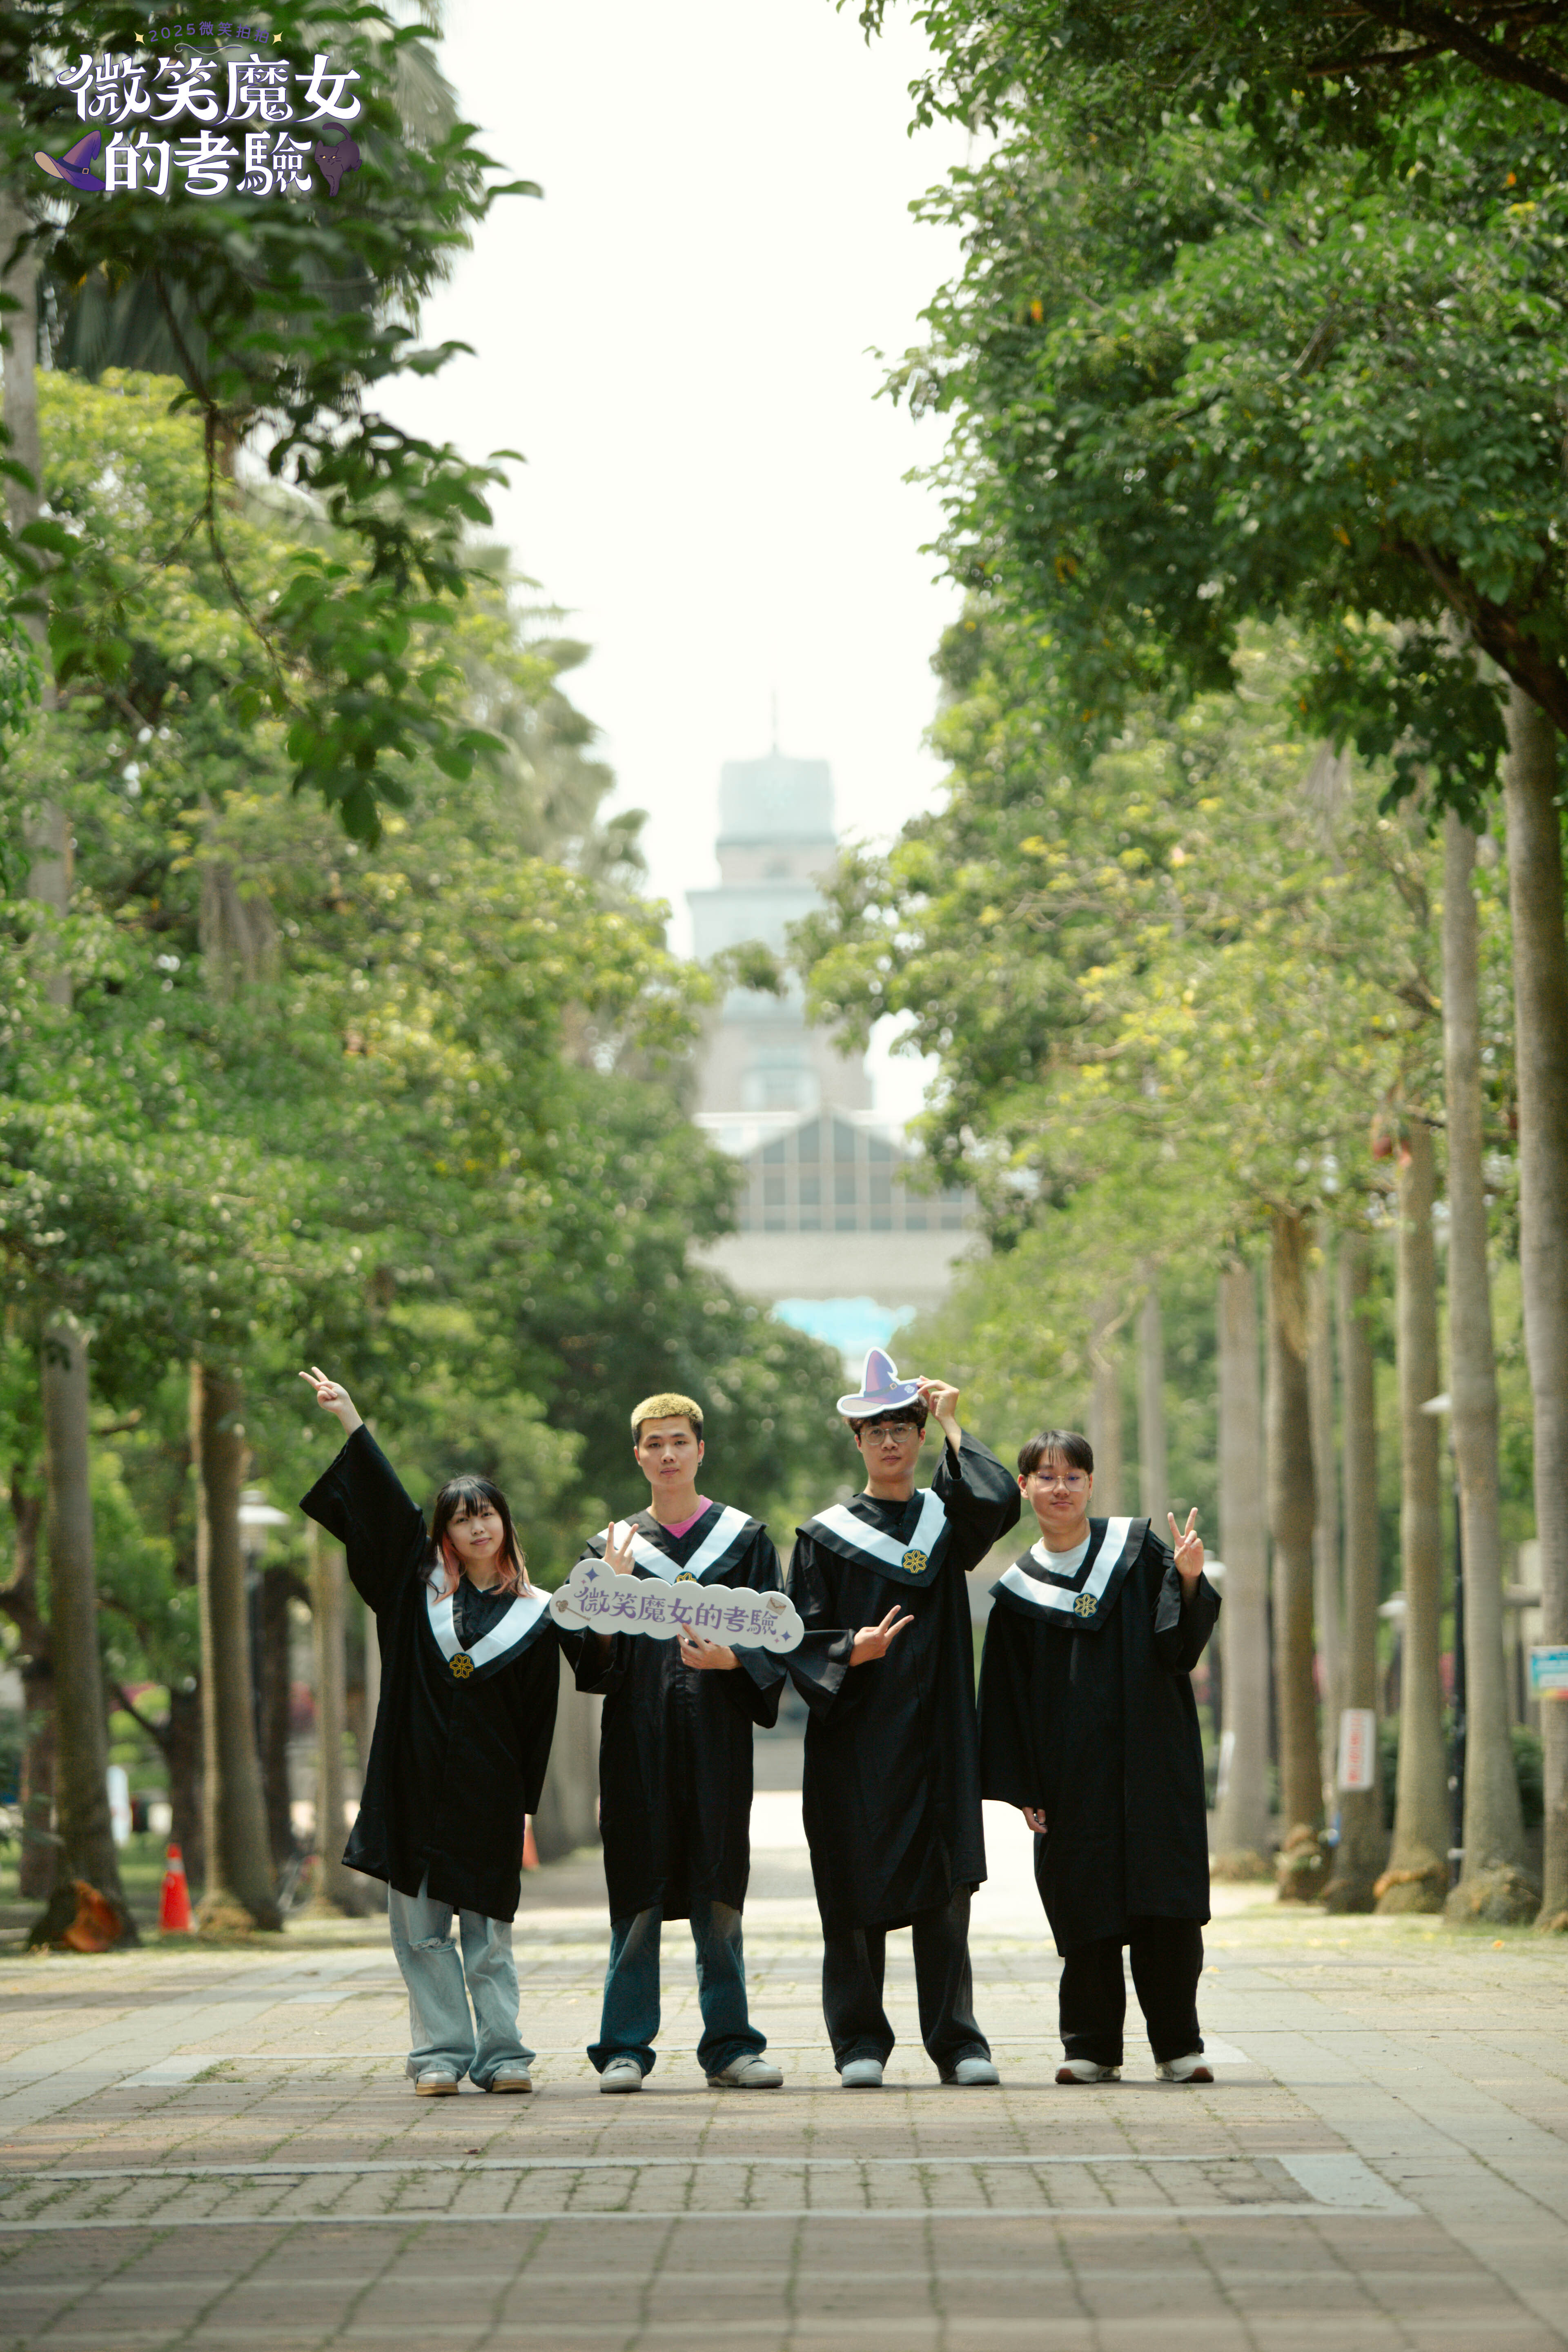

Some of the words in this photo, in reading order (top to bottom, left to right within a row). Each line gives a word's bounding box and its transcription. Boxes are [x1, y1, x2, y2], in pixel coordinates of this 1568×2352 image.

[574, 1586, 778, 1635] 微笑魔女的考驗
